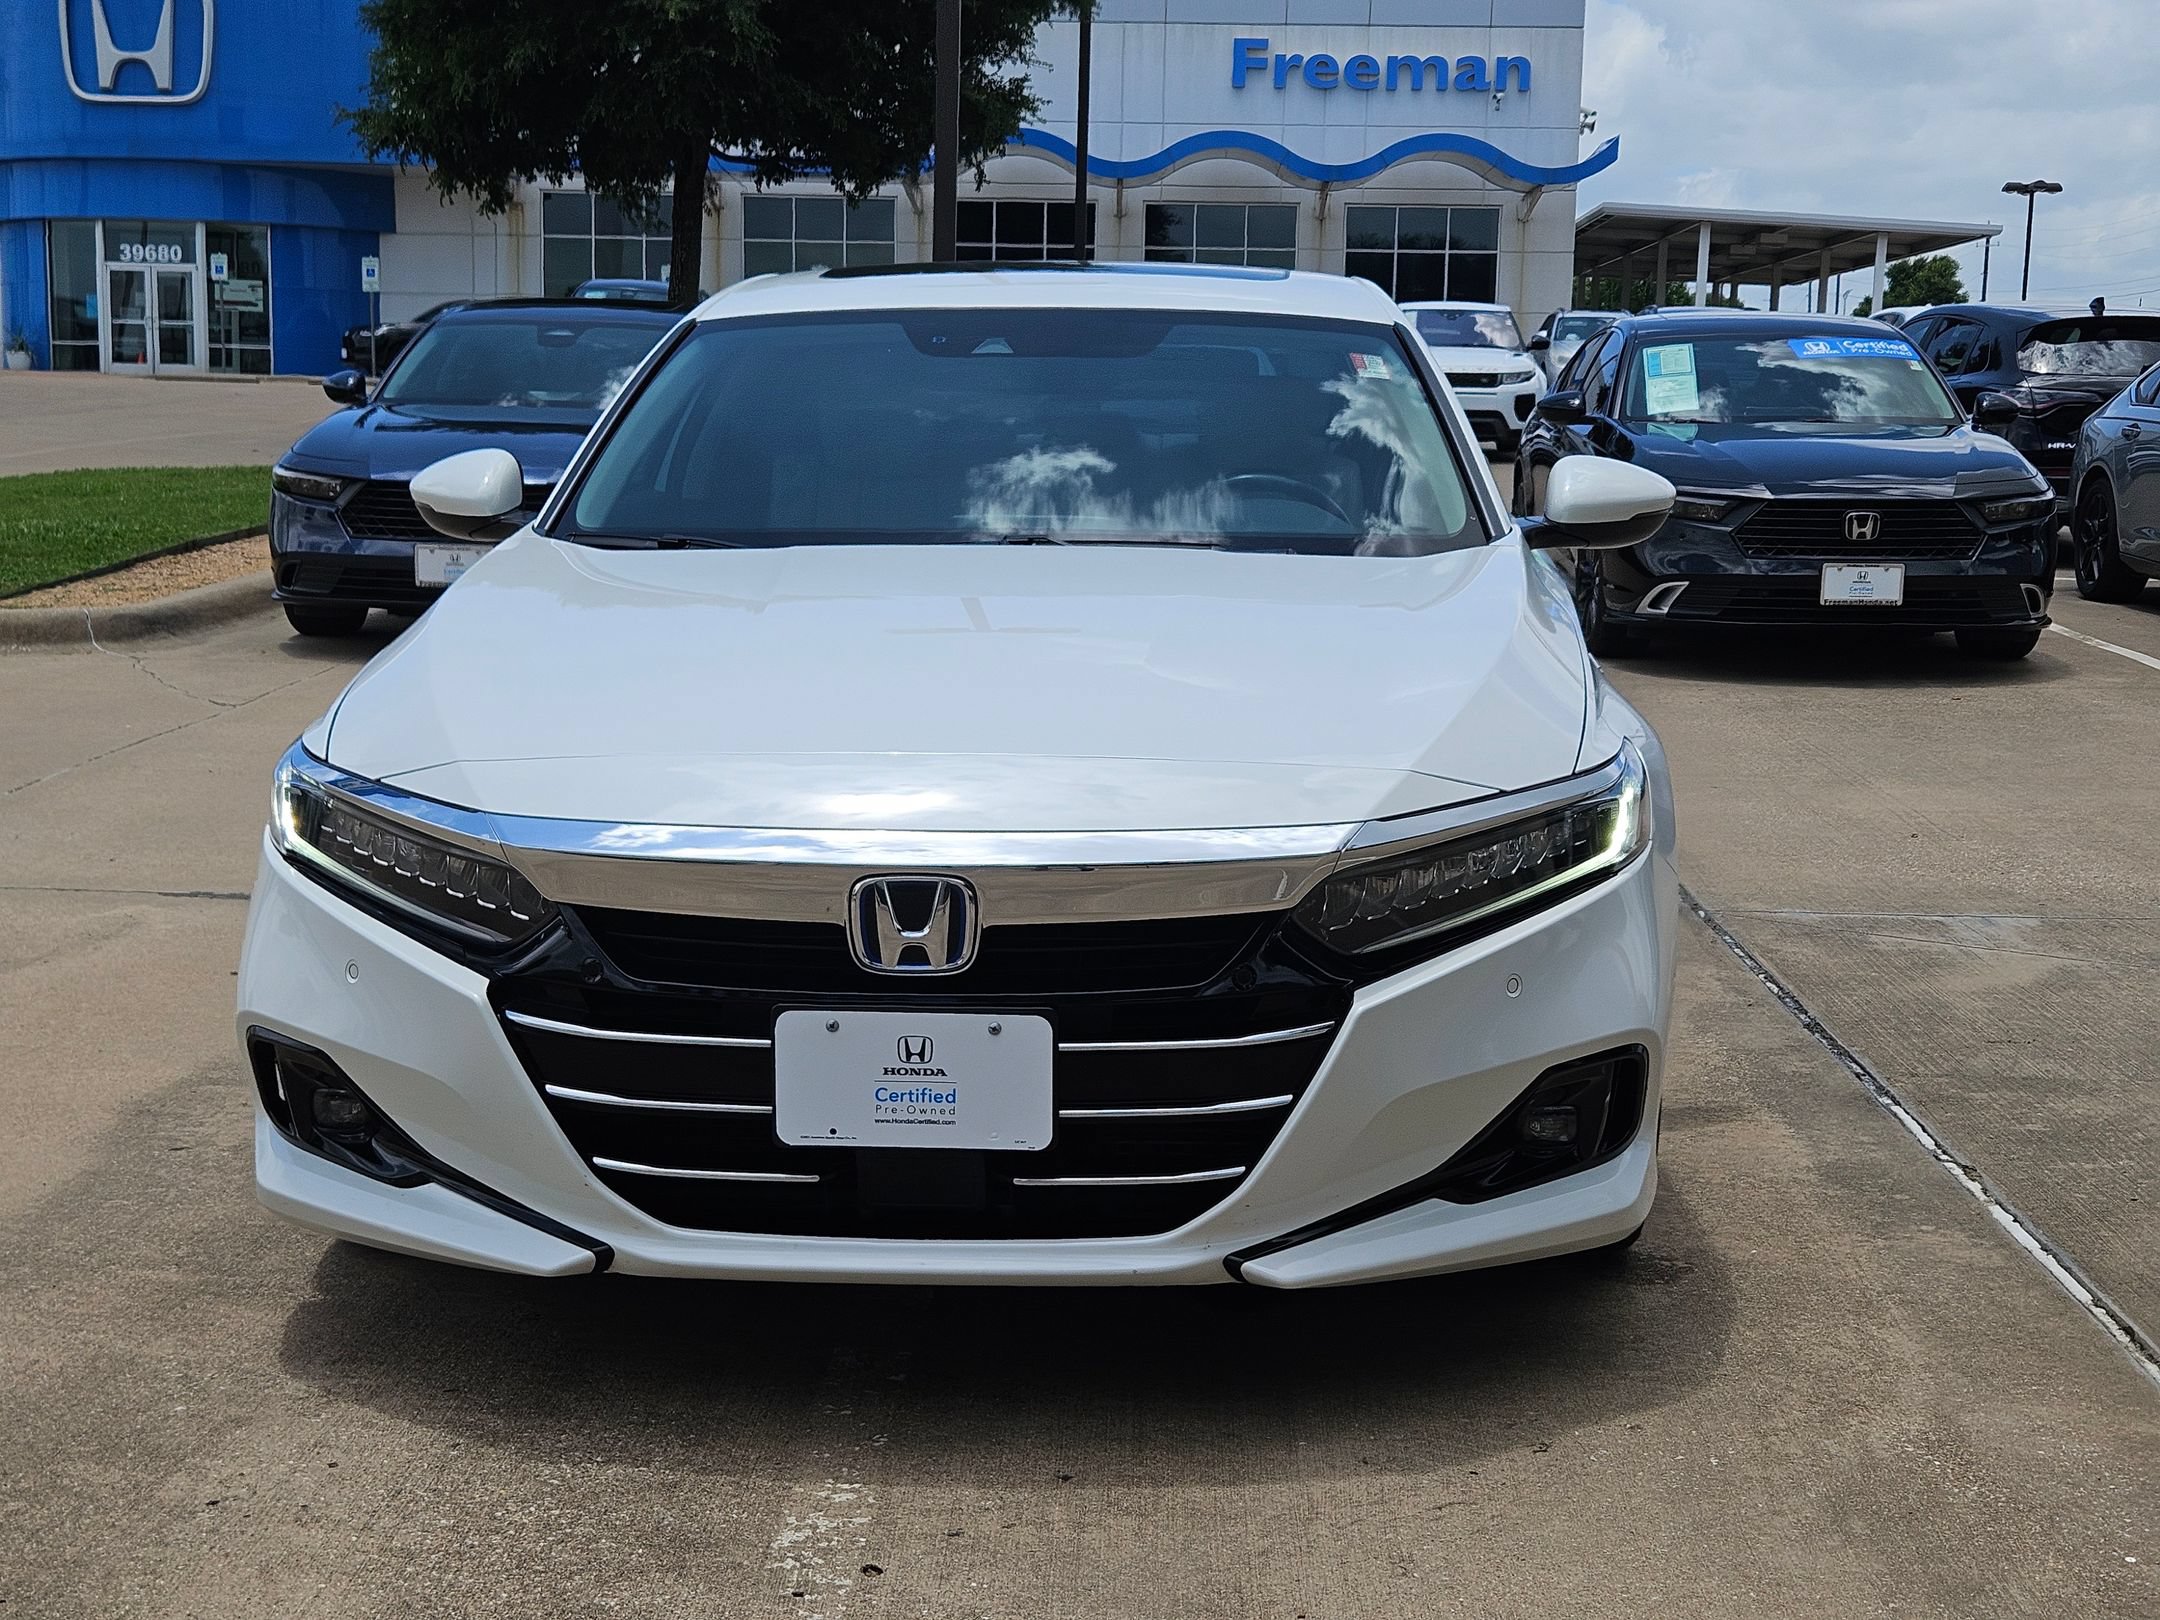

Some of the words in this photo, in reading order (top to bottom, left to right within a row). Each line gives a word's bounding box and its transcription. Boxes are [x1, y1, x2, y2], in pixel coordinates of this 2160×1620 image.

[1232, 38, 1531, 92] Freeman
[120, 243, 183, 263] 39680
[1843, 341, 1909, 351] Certified
[882, 1067, 948, 1077] HONDA
[875, 1087, 957, 1104] Certified
[875, 1104, 956, 1116] Pre-Owned
[874, 1118, 957, 1126] www.HondaCertified.com
